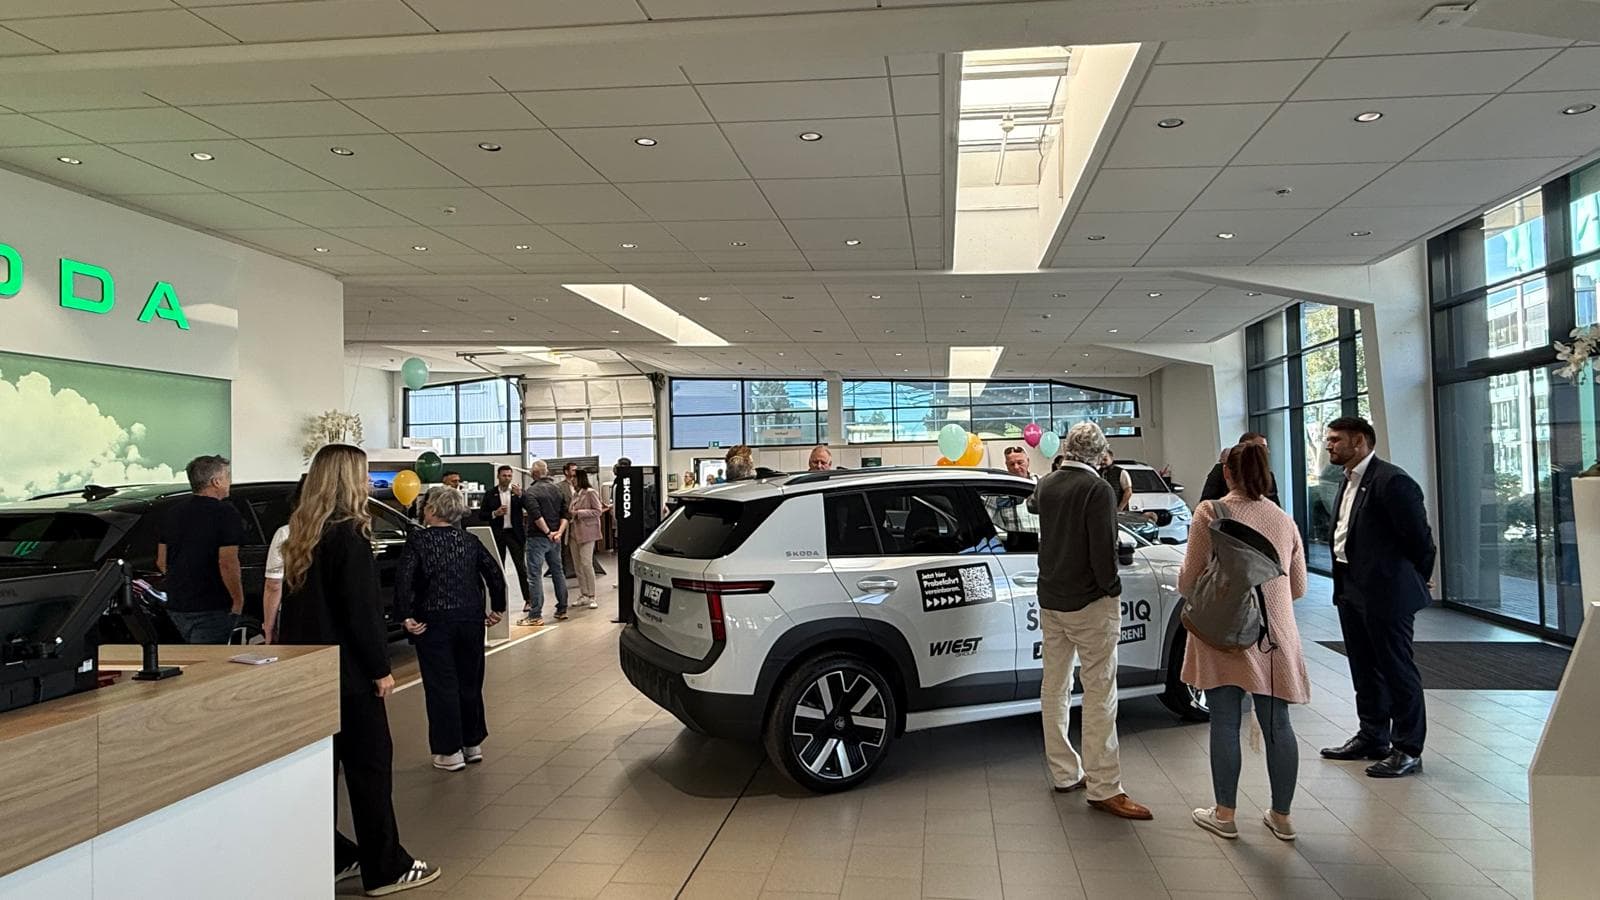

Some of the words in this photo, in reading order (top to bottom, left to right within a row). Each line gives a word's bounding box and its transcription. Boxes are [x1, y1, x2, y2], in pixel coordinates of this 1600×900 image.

[923, 577, 959, 588] Probefahrt
[1120, 599, 1151, 621] PIQ
[1121, 626, 1143, 641] REN!
[930, 636, 983, 656] WIEST
